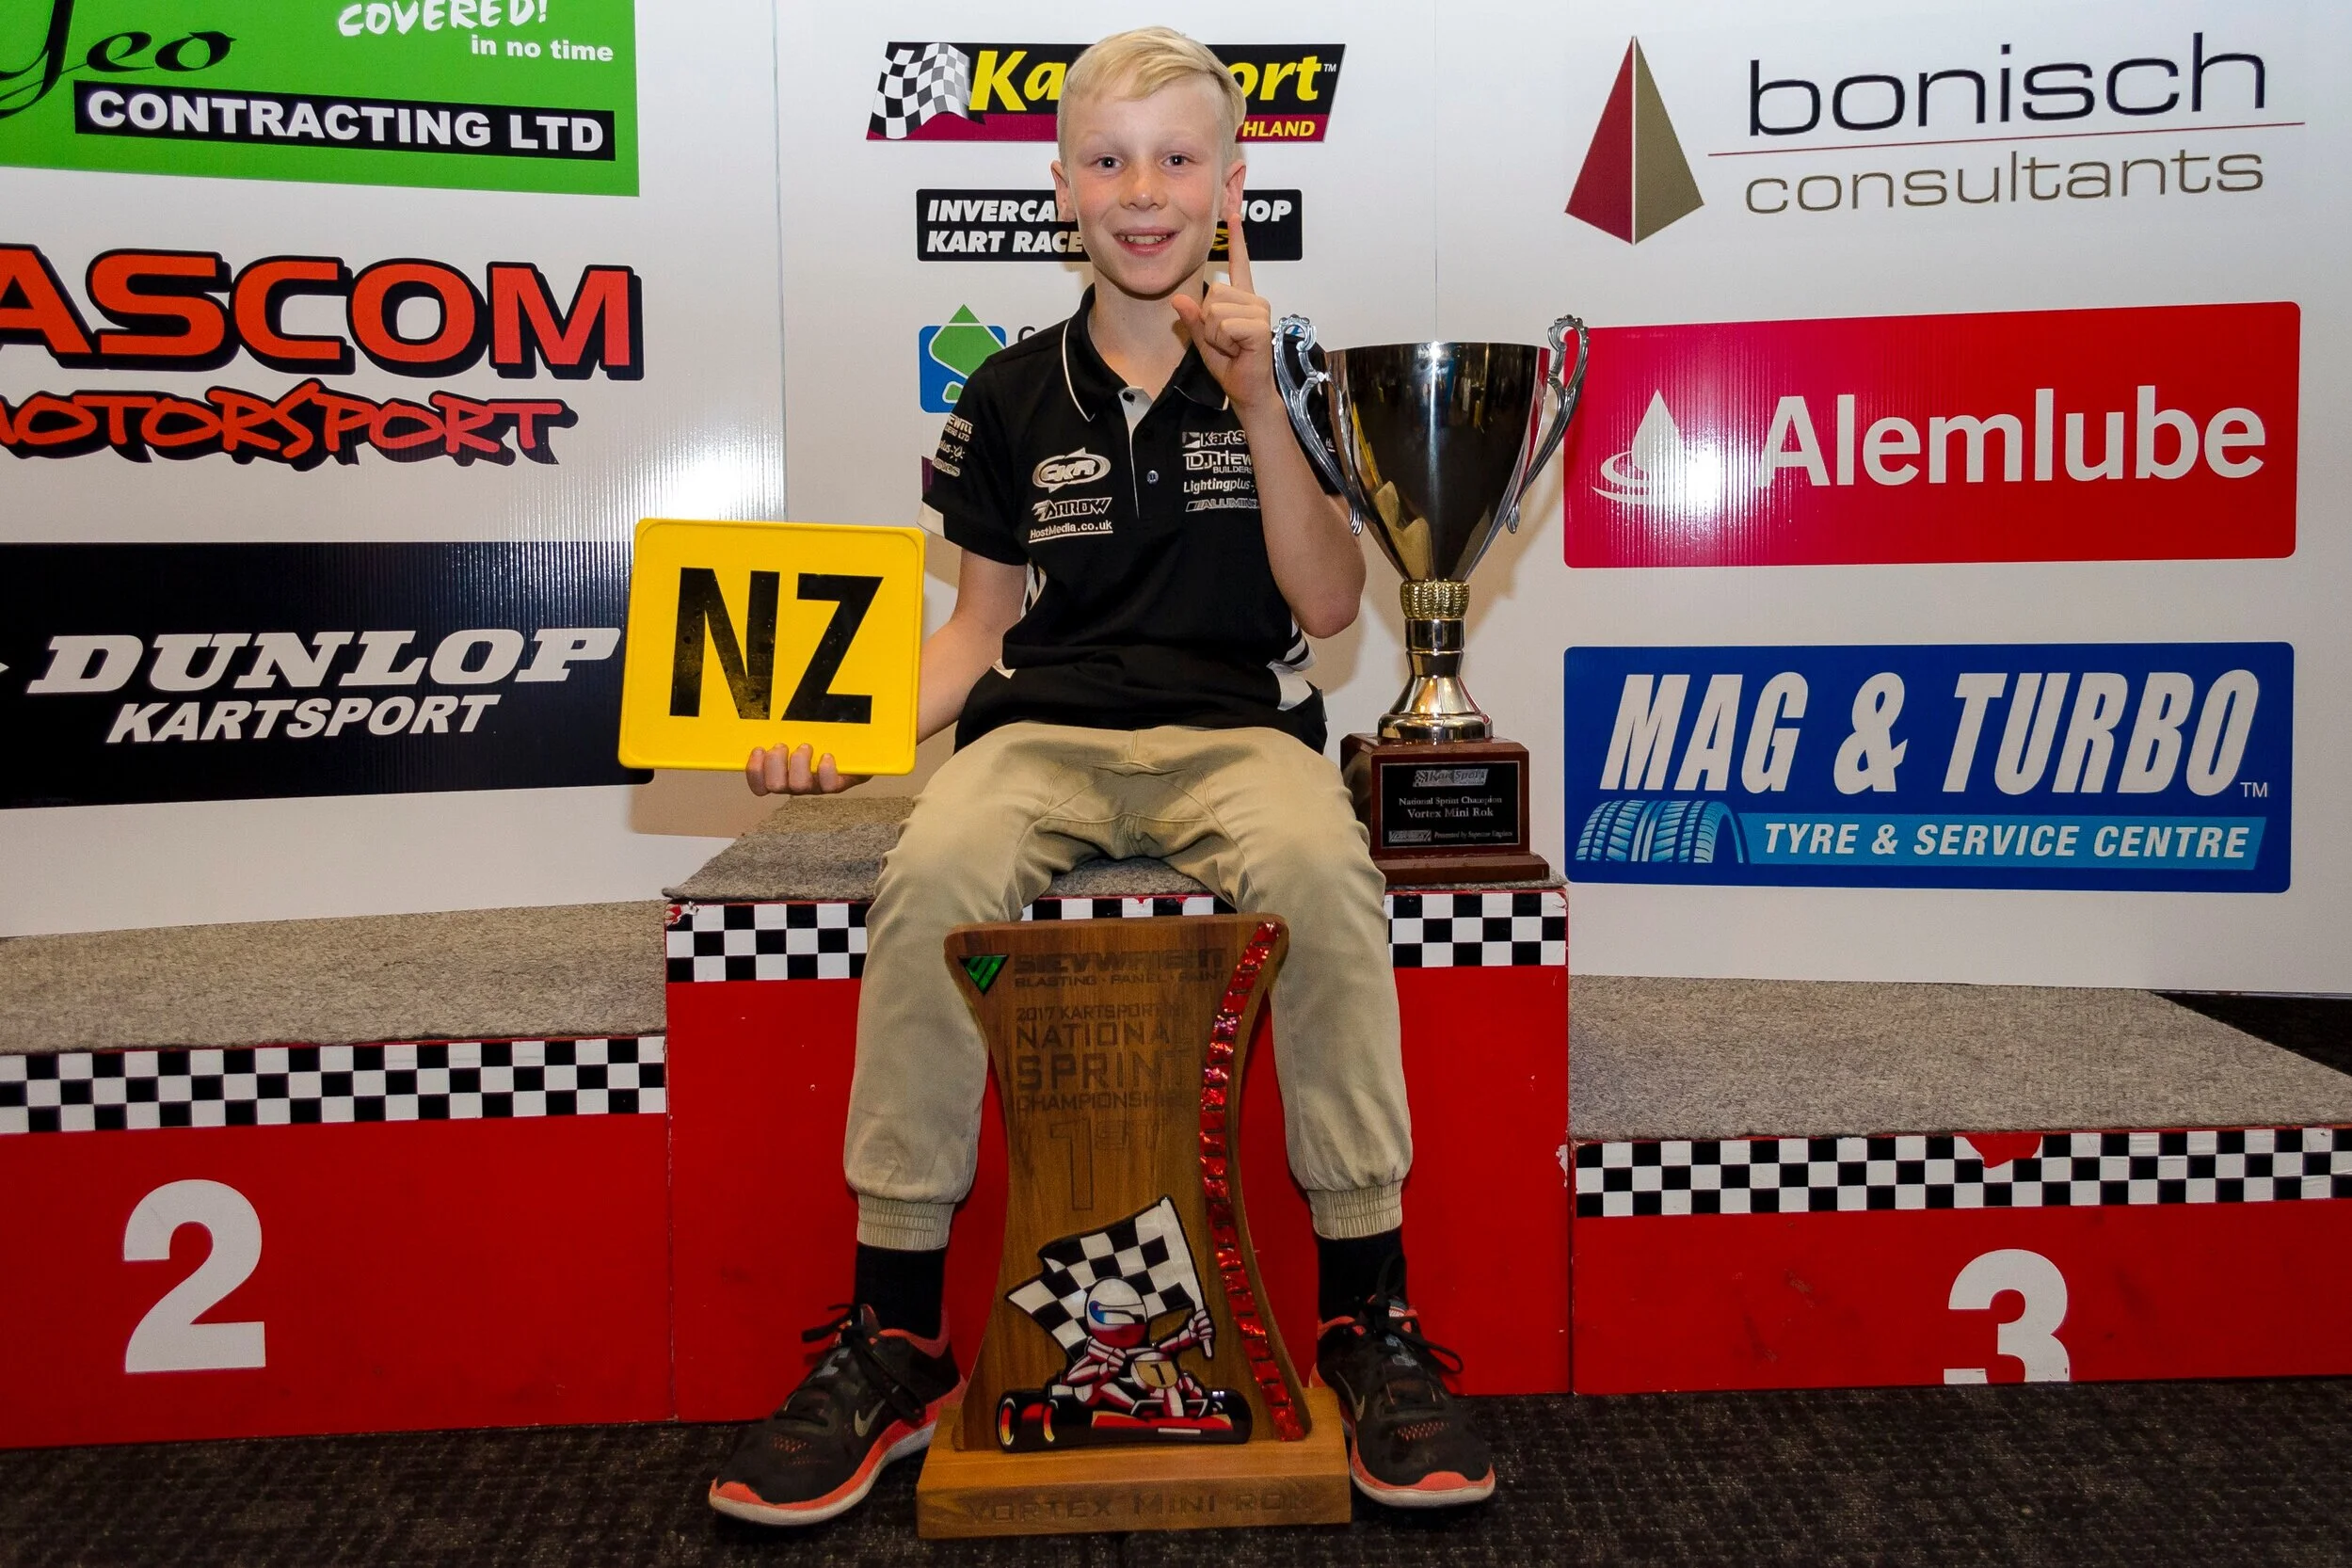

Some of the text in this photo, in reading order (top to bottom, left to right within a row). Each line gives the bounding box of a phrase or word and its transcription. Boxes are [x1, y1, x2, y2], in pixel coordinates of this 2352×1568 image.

[472, 34, 614, 61] in no time
[1749, 32, 2265, 136] bonisch
[88, 90, 604, 152] CONTRACTING LTD
[1242, 120, 1316, 137] HLAND
[1746, 149, 2264, 215] consultants
[927, 200, 1058, 222] INVERCA
[927, 231, 1005, 253] KART
[0, 377, 578, 471] OTORSPORT
[1755, 385, 2265, 487] Alemlube
[1183, 477, 1251, 494] Lightingplus
[1032, 497, 1112, 521] ARROW
[1030, 520, 1112, 539] HostMedia.co.uk
[669, 567, 884, 724] NZ
[26, 627, 619, 695] DUNLOP
[106, 694, 501, 744] KARTSPORT
[1599, 671, 1809, 794] MAG
[1832, 671, 1908, 794] &
[1942, 669, 2260, 797] TURBO
[1399, 795, 1502, 807] National Sprint Champion
[1407, 807, 1495, 818] Vortex Mini Rok
[1765, 824, 2249, 858] TYRE & SERVICE CENTRE
[1016, 1006, 1056, 1021] 2017
[1016, 1021, 1173, 1048] NATIONA
[123, 1178, 266, 1374] 2
[1944, 1248, 2071, 1384] 3
[1150, 1363, 1165, 1385] 1
